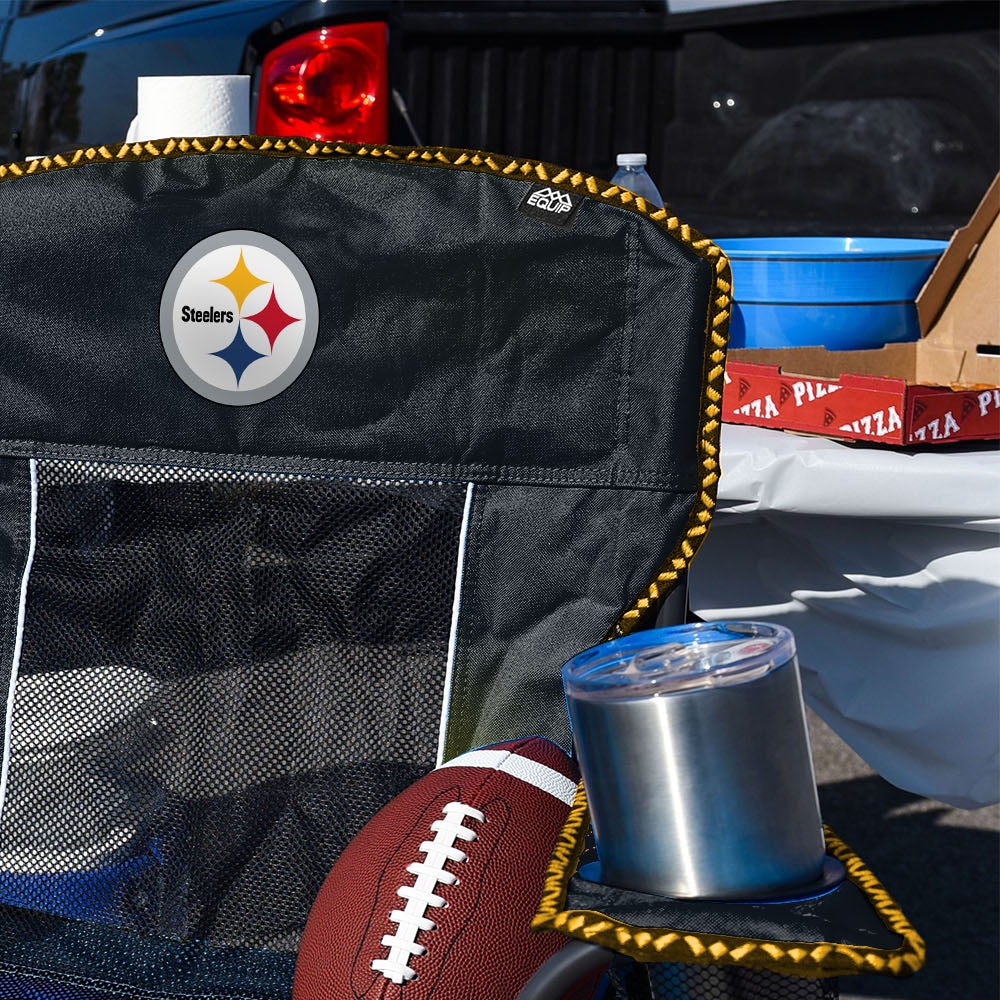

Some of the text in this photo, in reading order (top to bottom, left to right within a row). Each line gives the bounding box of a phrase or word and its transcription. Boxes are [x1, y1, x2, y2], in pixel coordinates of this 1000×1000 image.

[526, 193, 572, 214] EQUIP
[181, 305, 234, 323] Steelers
[792, 381, 844, 407] PIZ
[908, 411, 961, 442] ZZA
